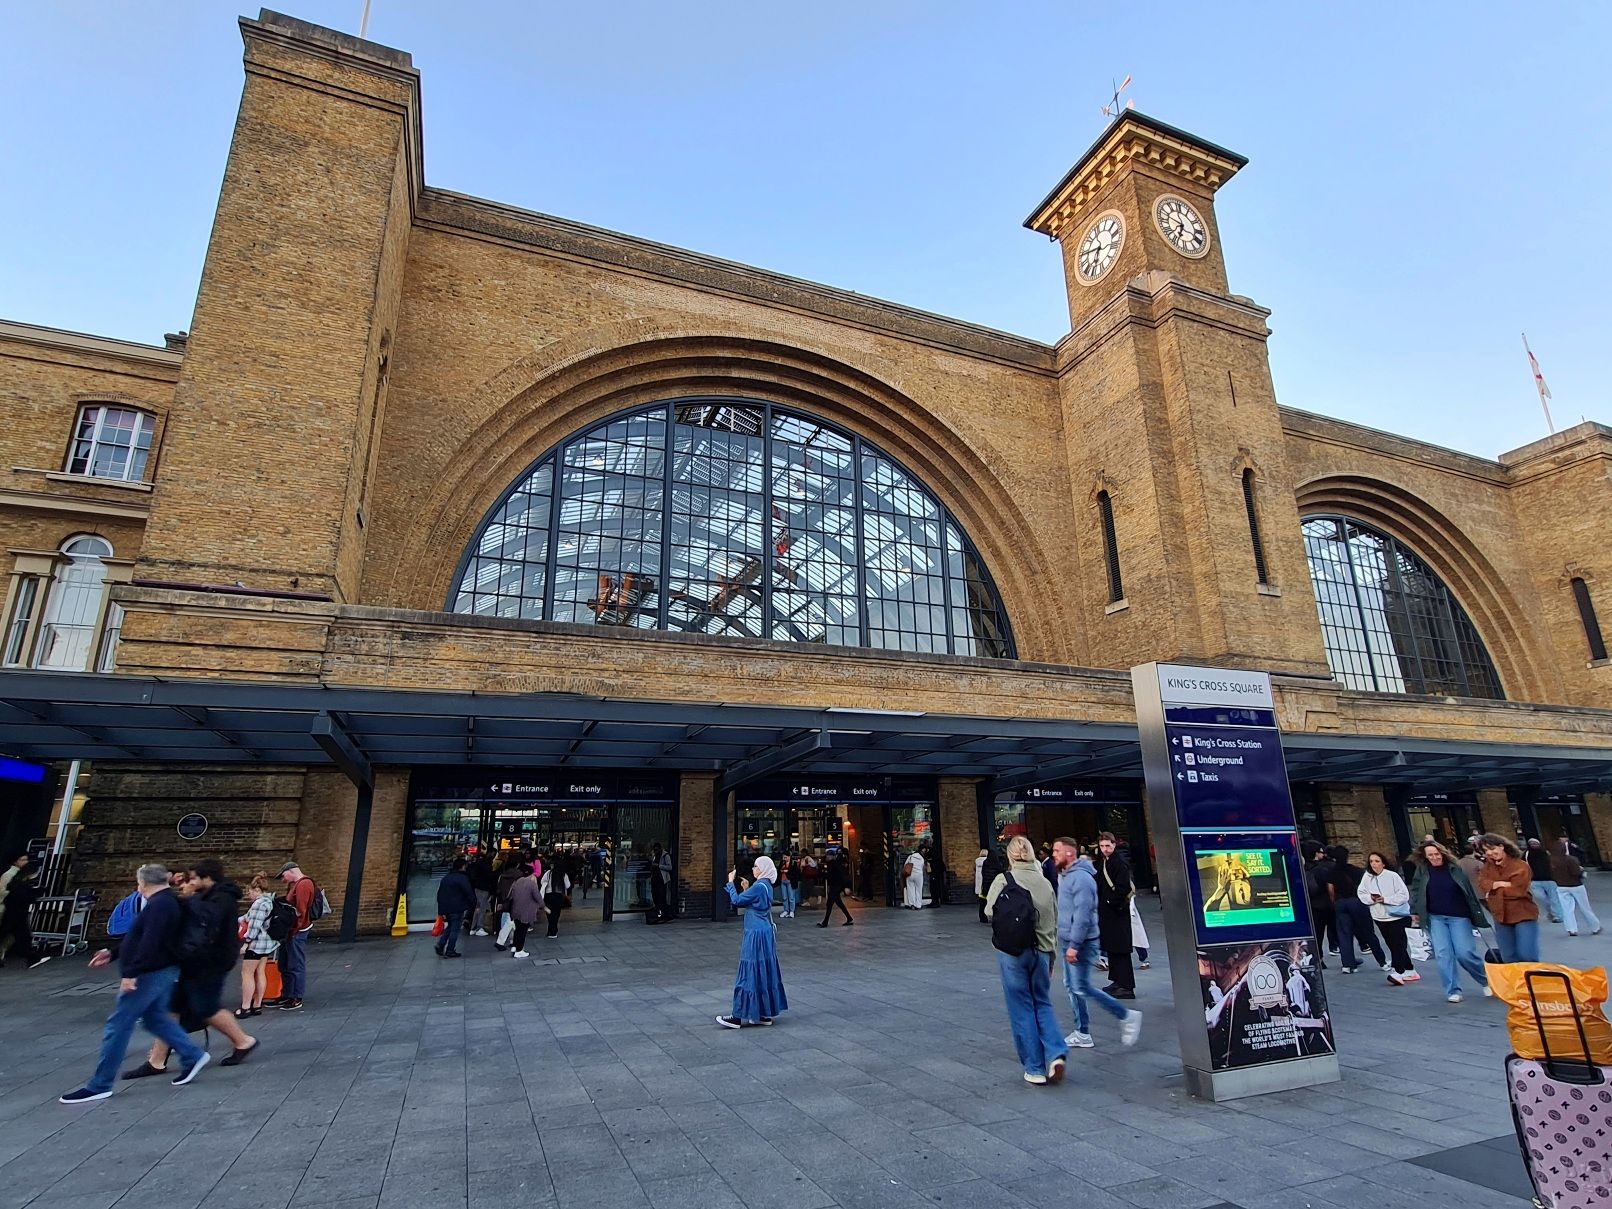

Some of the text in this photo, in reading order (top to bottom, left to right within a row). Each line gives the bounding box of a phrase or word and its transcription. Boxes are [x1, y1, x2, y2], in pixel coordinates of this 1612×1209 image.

[1167, 678, 1264, 694] KING'S CROSS SQUARE
[1194, 738, 1262, 749] King's Cross Station
[1197, 754, 1244, 767] Underground
[1200, 772, 1219, 781] Taxis
[515, 785, 601, 794] Entrance Exit only
[865, 788, 877, 796] only
[509, 825, 515, 833] 8
[1253, 973, 1277, 990] 100
